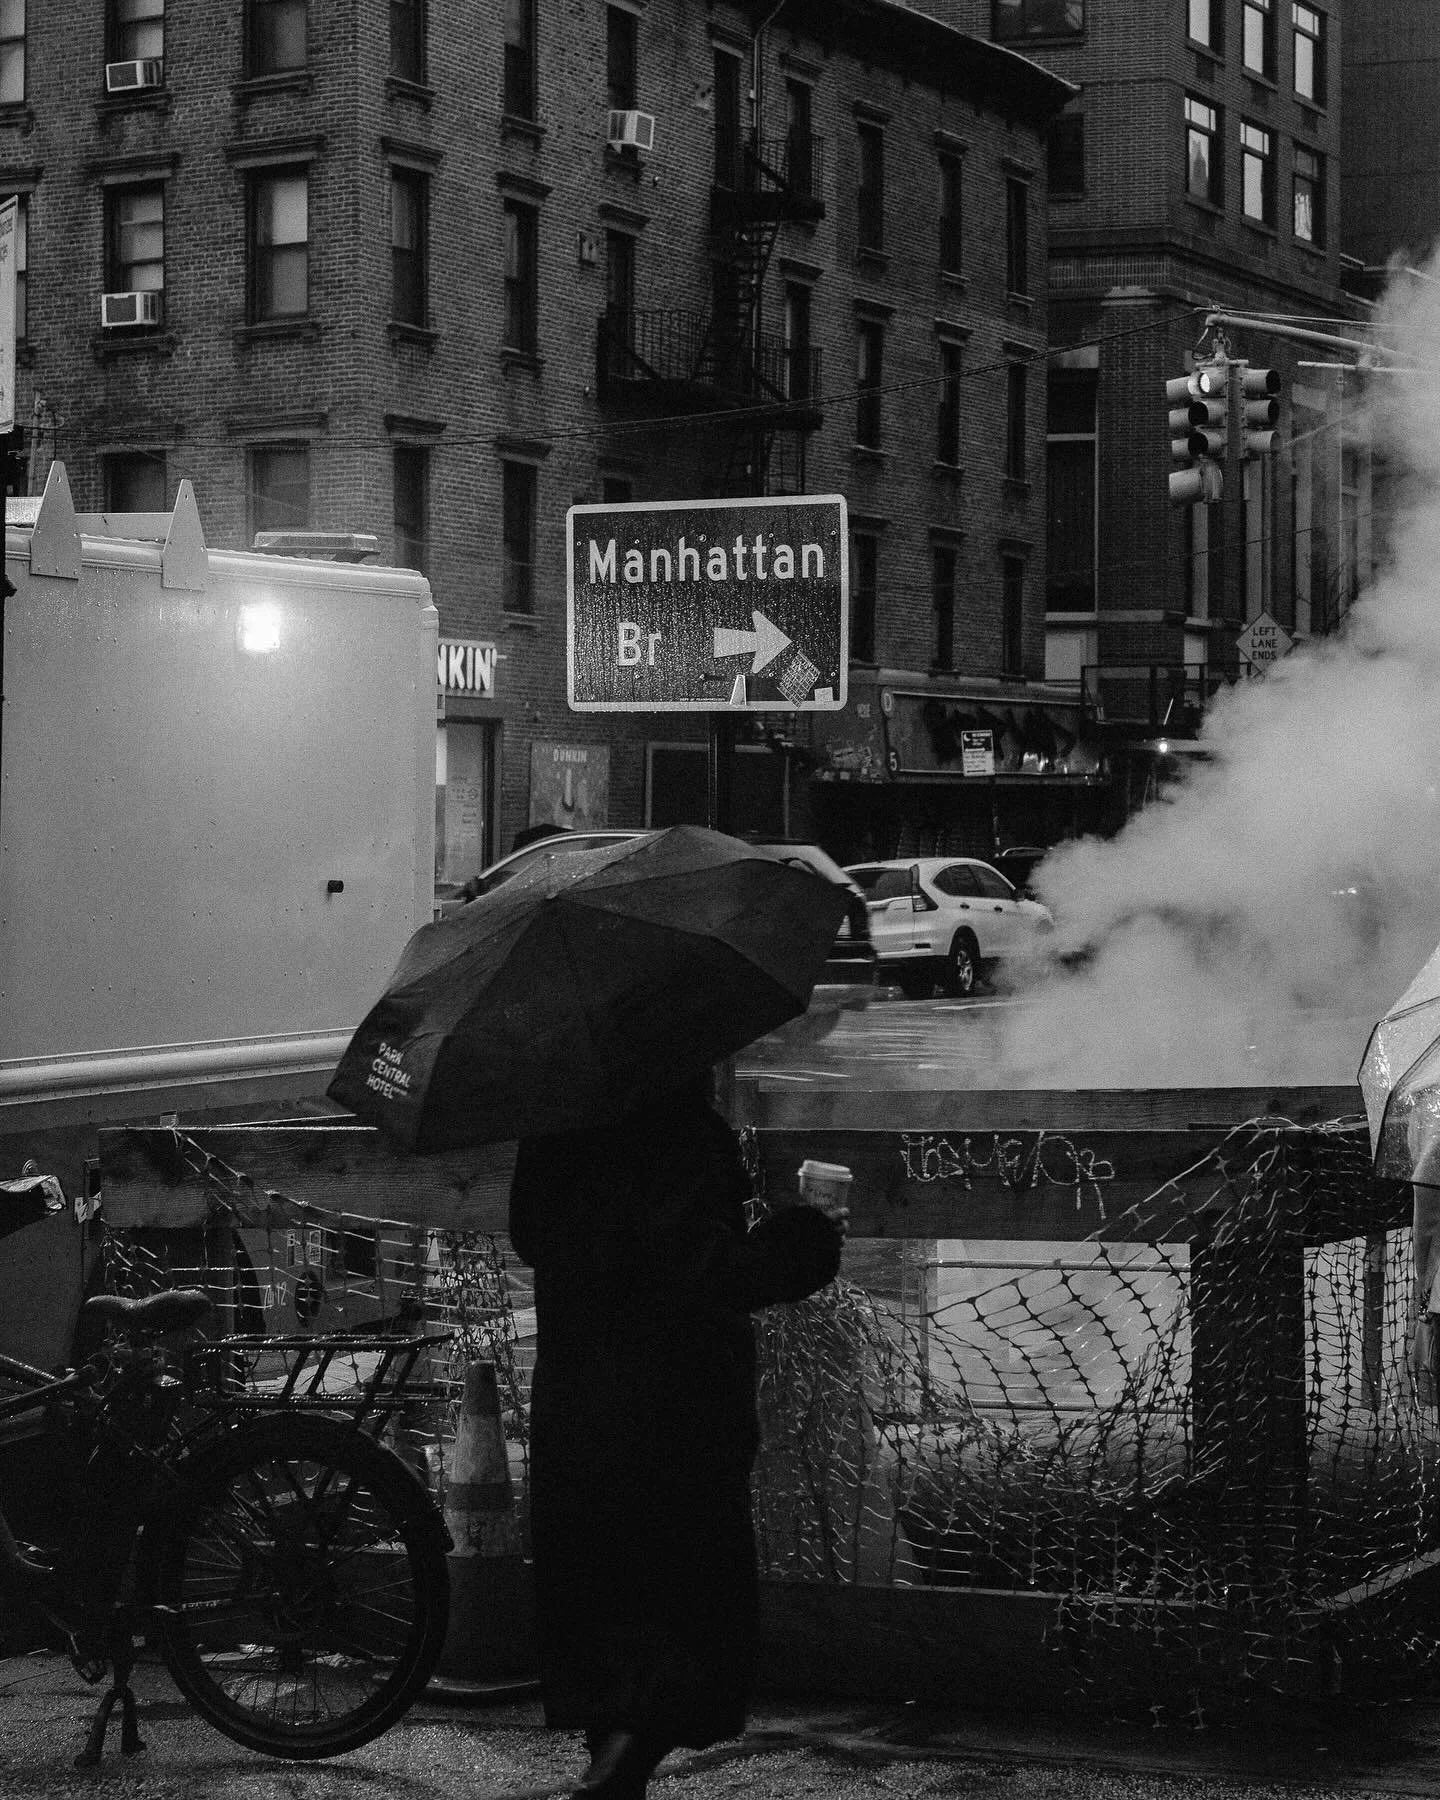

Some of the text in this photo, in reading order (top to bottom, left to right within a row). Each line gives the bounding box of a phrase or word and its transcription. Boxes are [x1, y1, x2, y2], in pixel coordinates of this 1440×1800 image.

[589, 534, 824, 584] Manhattan
[1252, 626, 1276, 636] LEFT
[617, 621, 662, 666] Br
[1251, 639, 1278, 648] LANE
[1252, 650, 1277, 661] ENDS
[378, 1042, 404, 1065] PARK
[372, 1058, 411, 1088] CENTRAL
[366, 1074, 394, 1100] HOTEL
